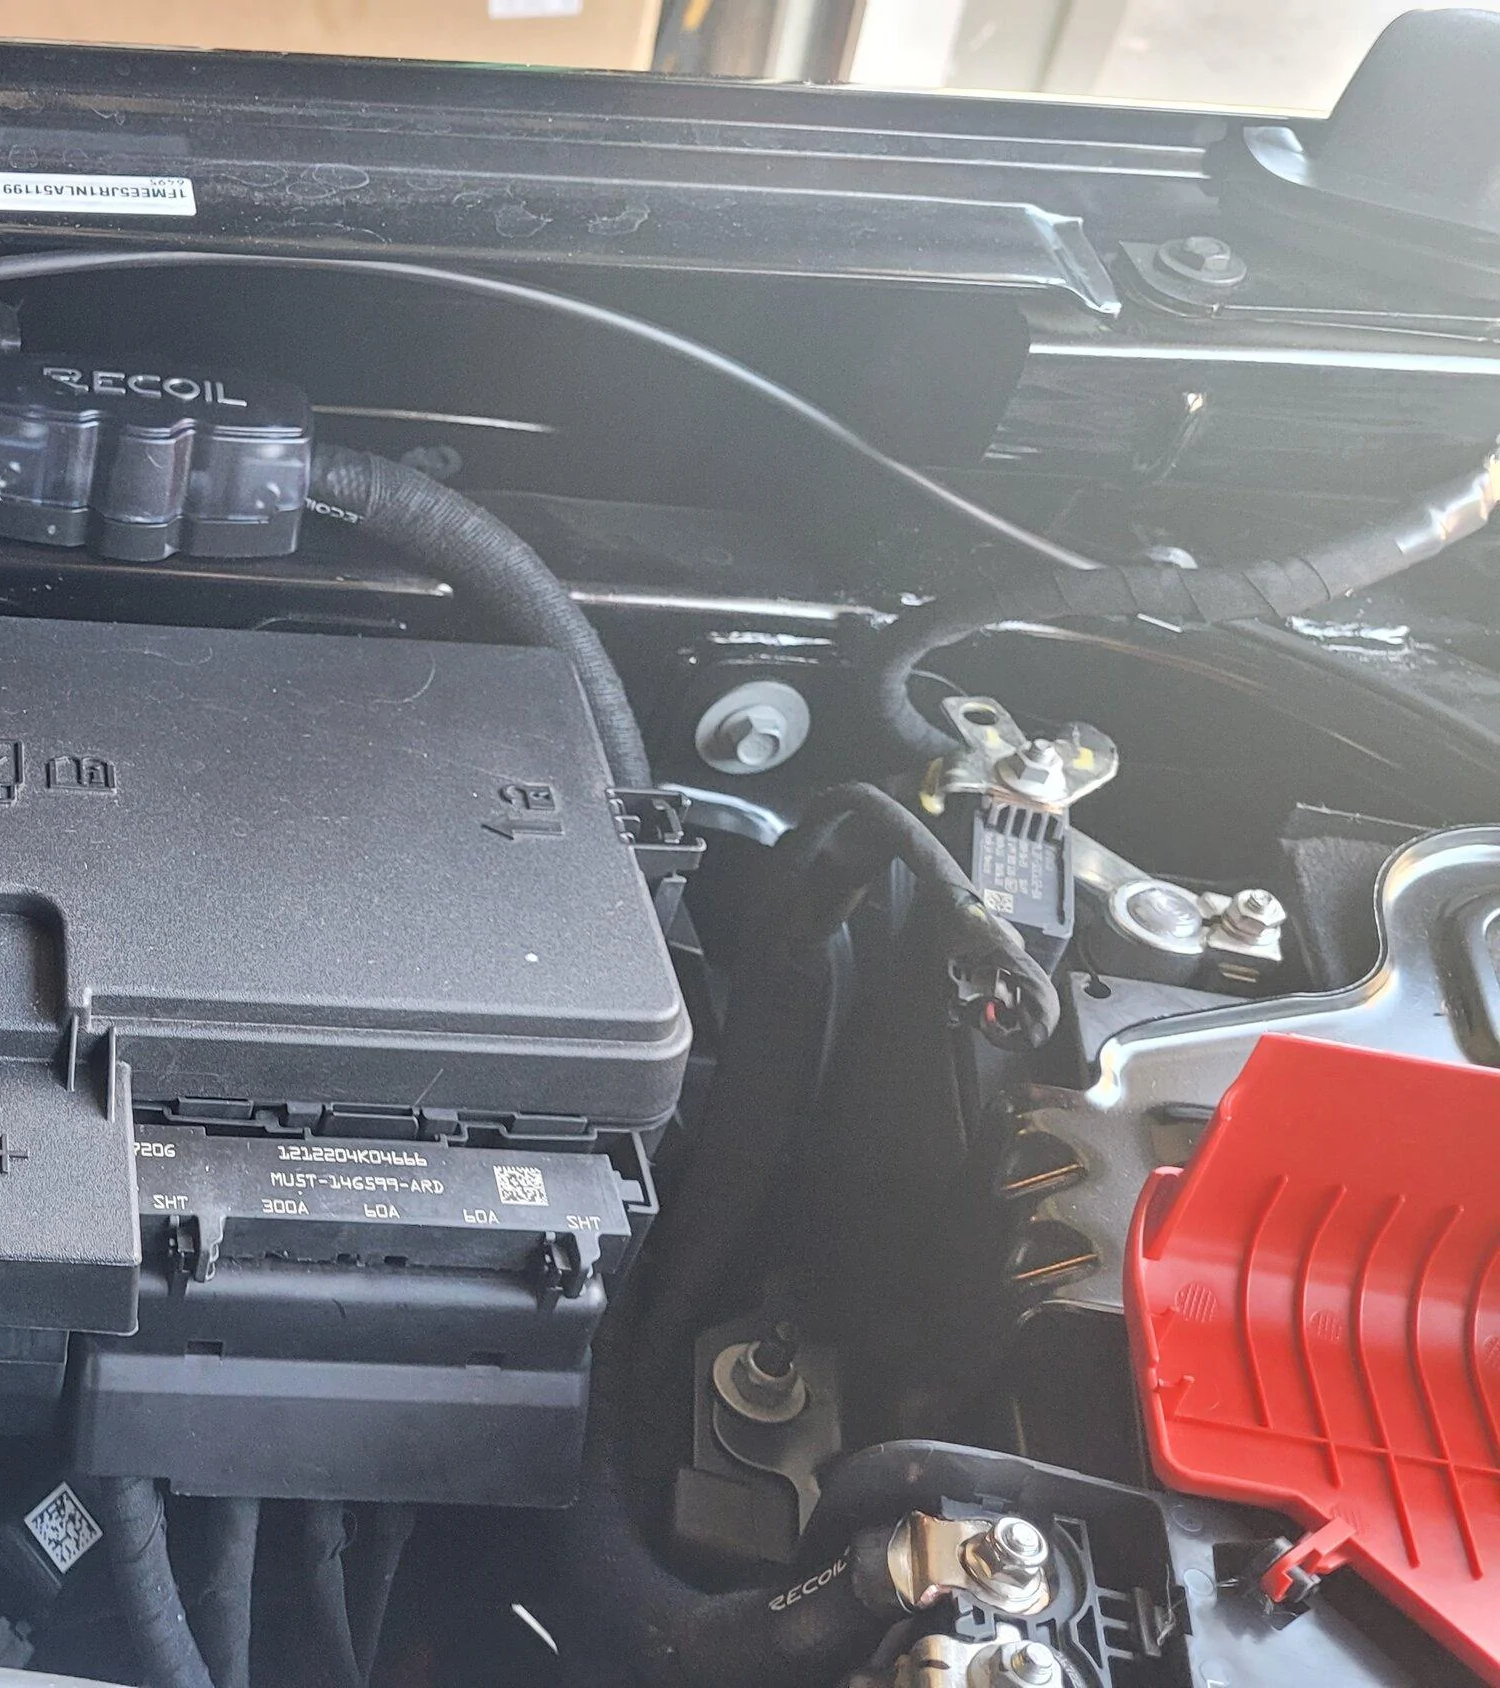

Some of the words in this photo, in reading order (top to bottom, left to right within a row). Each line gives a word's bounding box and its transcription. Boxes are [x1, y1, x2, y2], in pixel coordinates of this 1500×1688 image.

[3, 183, 188, 199] 1FMEE5JR1NLA51199
[43, 366, 247, 407] RECOIL
[277, 1145, 428, 1167] 1212204K04666
[153, 1194, 189, 1210] SHT
[262, 1199, 310, 1215] 300A
[364, 1203, 400, 1219] 60A
[463, 1209, 500, 1224] 60A
[566, 1215, 602, 1231] SHT
[768, 1559, 848, 1612] RECOIL
